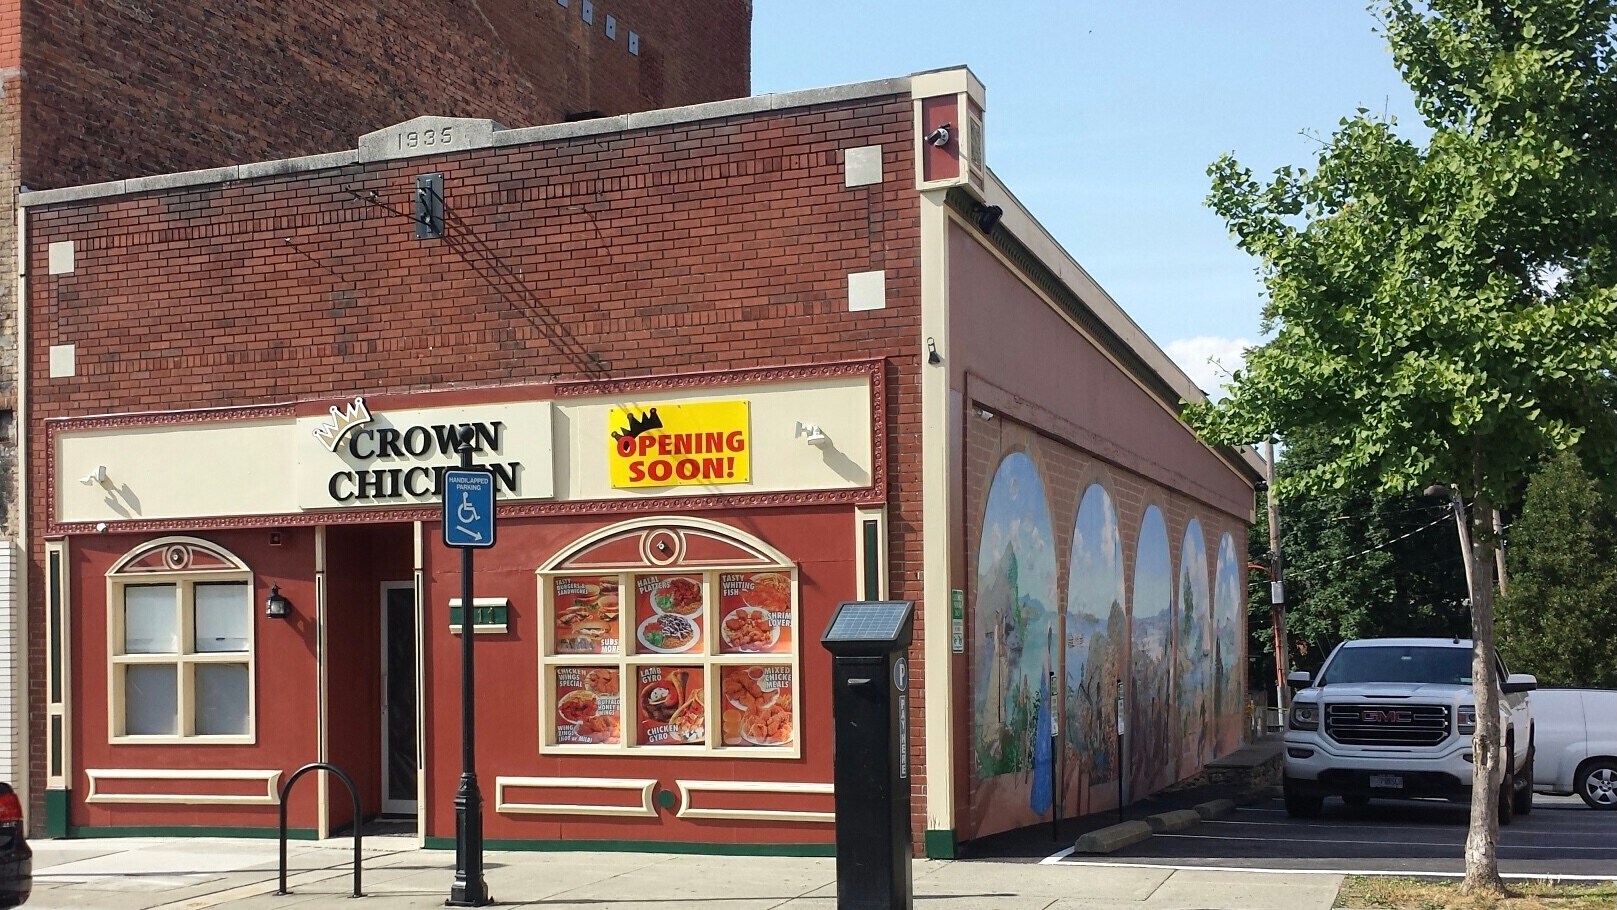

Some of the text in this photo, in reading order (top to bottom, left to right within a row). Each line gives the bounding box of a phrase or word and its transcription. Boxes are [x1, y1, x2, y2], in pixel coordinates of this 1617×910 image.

[398, 127, 453, 150] 1935
[350, 421, 502, 460] CROWN
[617, 431, 745, 457] OPENING
[629, 457, 735, 482] SOON!
[329, 462, 520, 501] CHICN
[449, 477, 489, 485] HANDICAPPED
[637, 576, 659, 587] HALAL
[723, 582, 755, 590] WHITING
[639, 581, 671, 594] PLATTERS
[723, 588, 738, 596] FISH
[768, 619, 792, 627] LOVER
[600, 638, 619, 646] SUBS
[557, 668, 586, 676] CHICKEN
[640, 667, 661, 677] LAMB
[764, 667, 790, 675] MIXED
[900, 664, 905, 686] P
[642, 674, 662, 683] GYRO
[766, 680, 789, 689] MEALS
[1361, 711, 1412, 722] GMC
[647, 724, 678, 736] CHICKEN
[649, 733, 668, 742] GYRO
